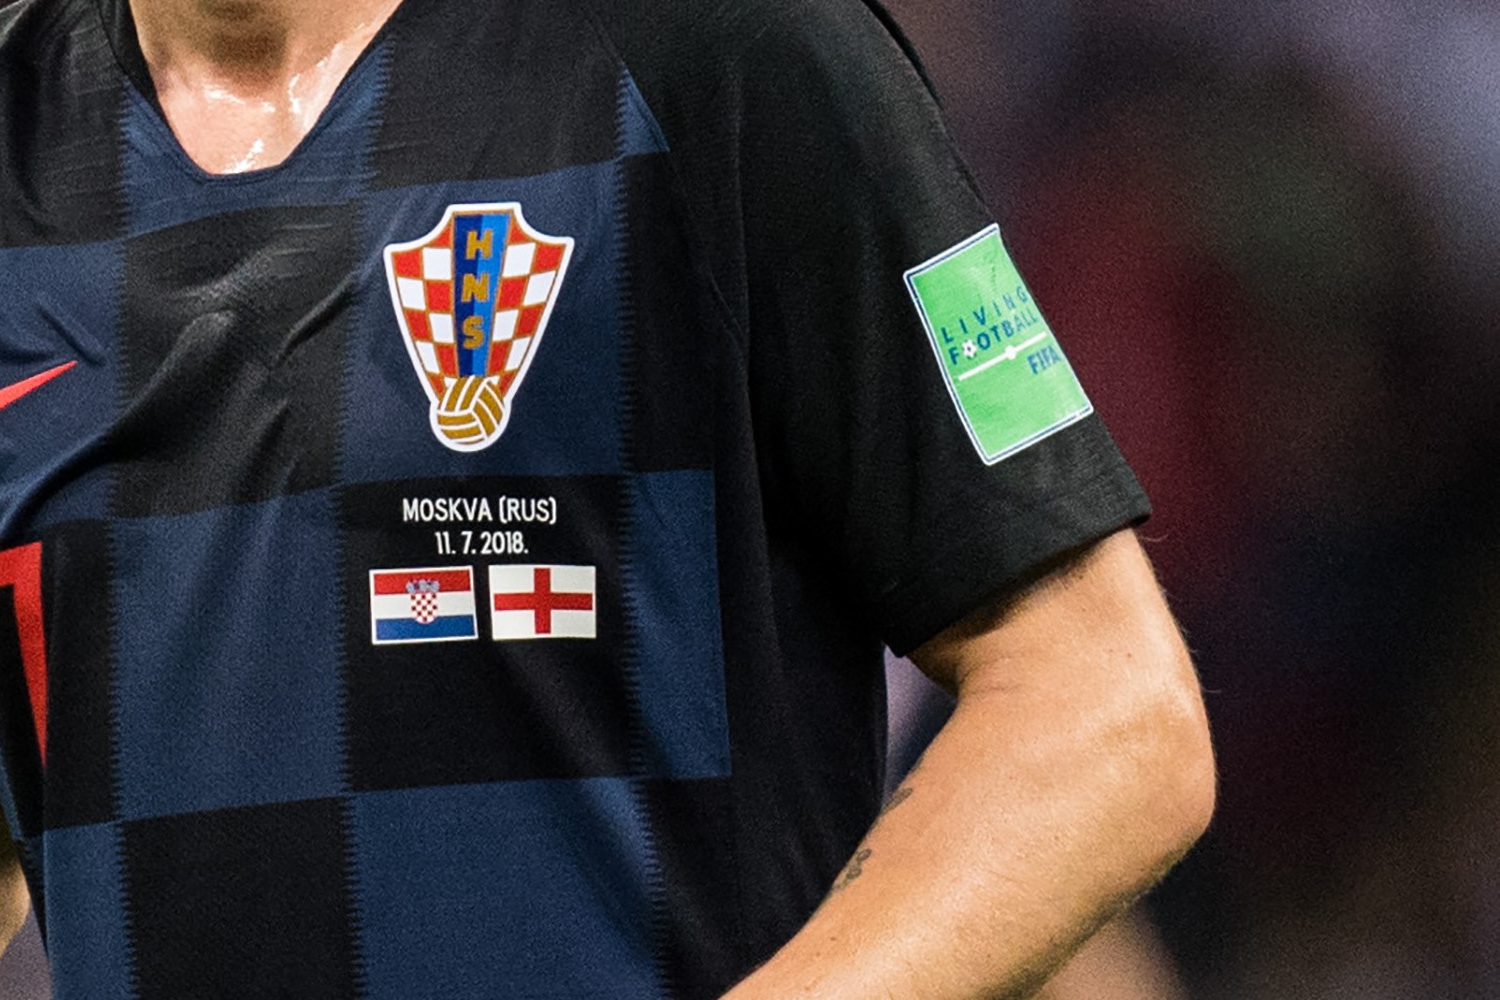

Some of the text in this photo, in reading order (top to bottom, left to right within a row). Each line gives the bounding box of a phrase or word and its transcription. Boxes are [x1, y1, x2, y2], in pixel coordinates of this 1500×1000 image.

[461, 230, 493, 349] HNS
[941, 286, 1028, 344] LIVING
[1027, 345, 1061, 375] FIFA
[402, 495, 557, 525] MOSKVA (RUS)
[434, 530, 456, 555] 11.
[480, 530, 529, 555] 2018.
